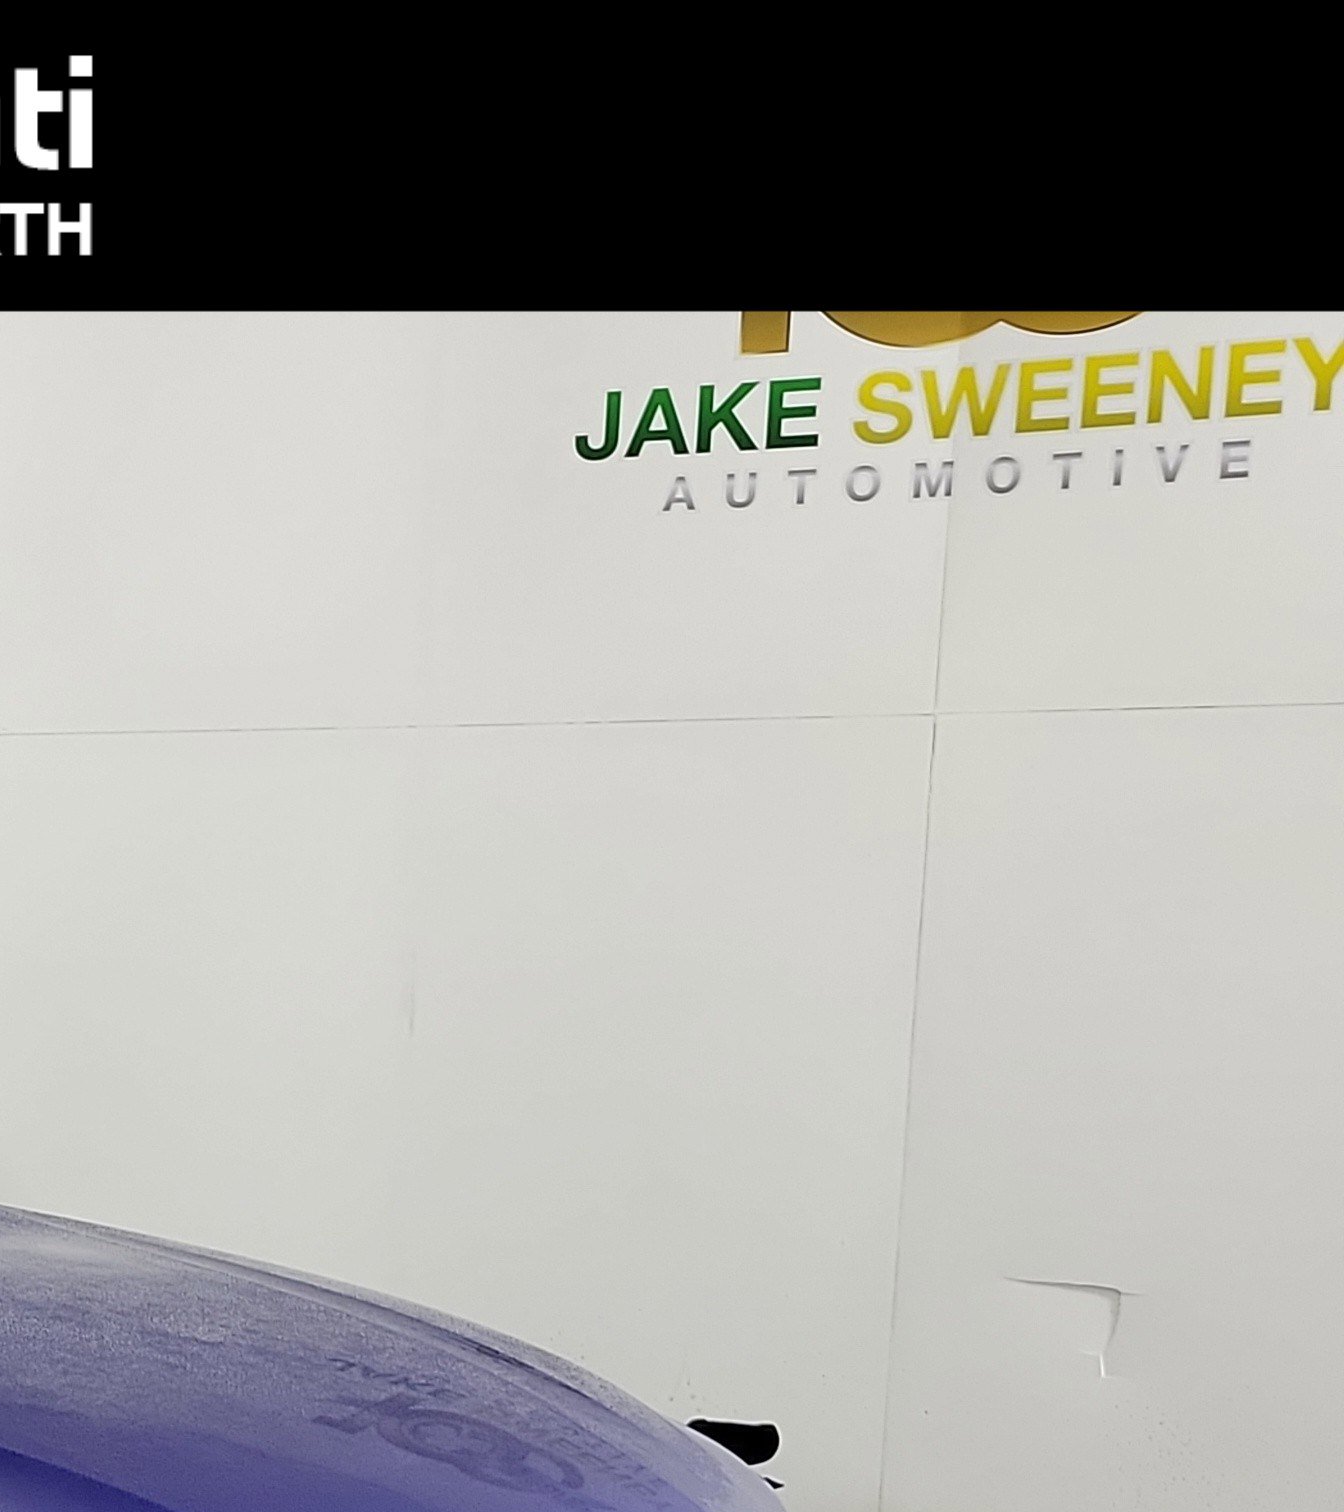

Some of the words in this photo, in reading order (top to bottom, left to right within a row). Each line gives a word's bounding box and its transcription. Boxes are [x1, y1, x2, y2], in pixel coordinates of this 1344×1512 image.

[575, 377, 822, 461] JAKE
[853, 336, 1344, 444] SWEENEY
[662, 440, 1252, 512] AUTOMOTIVE
